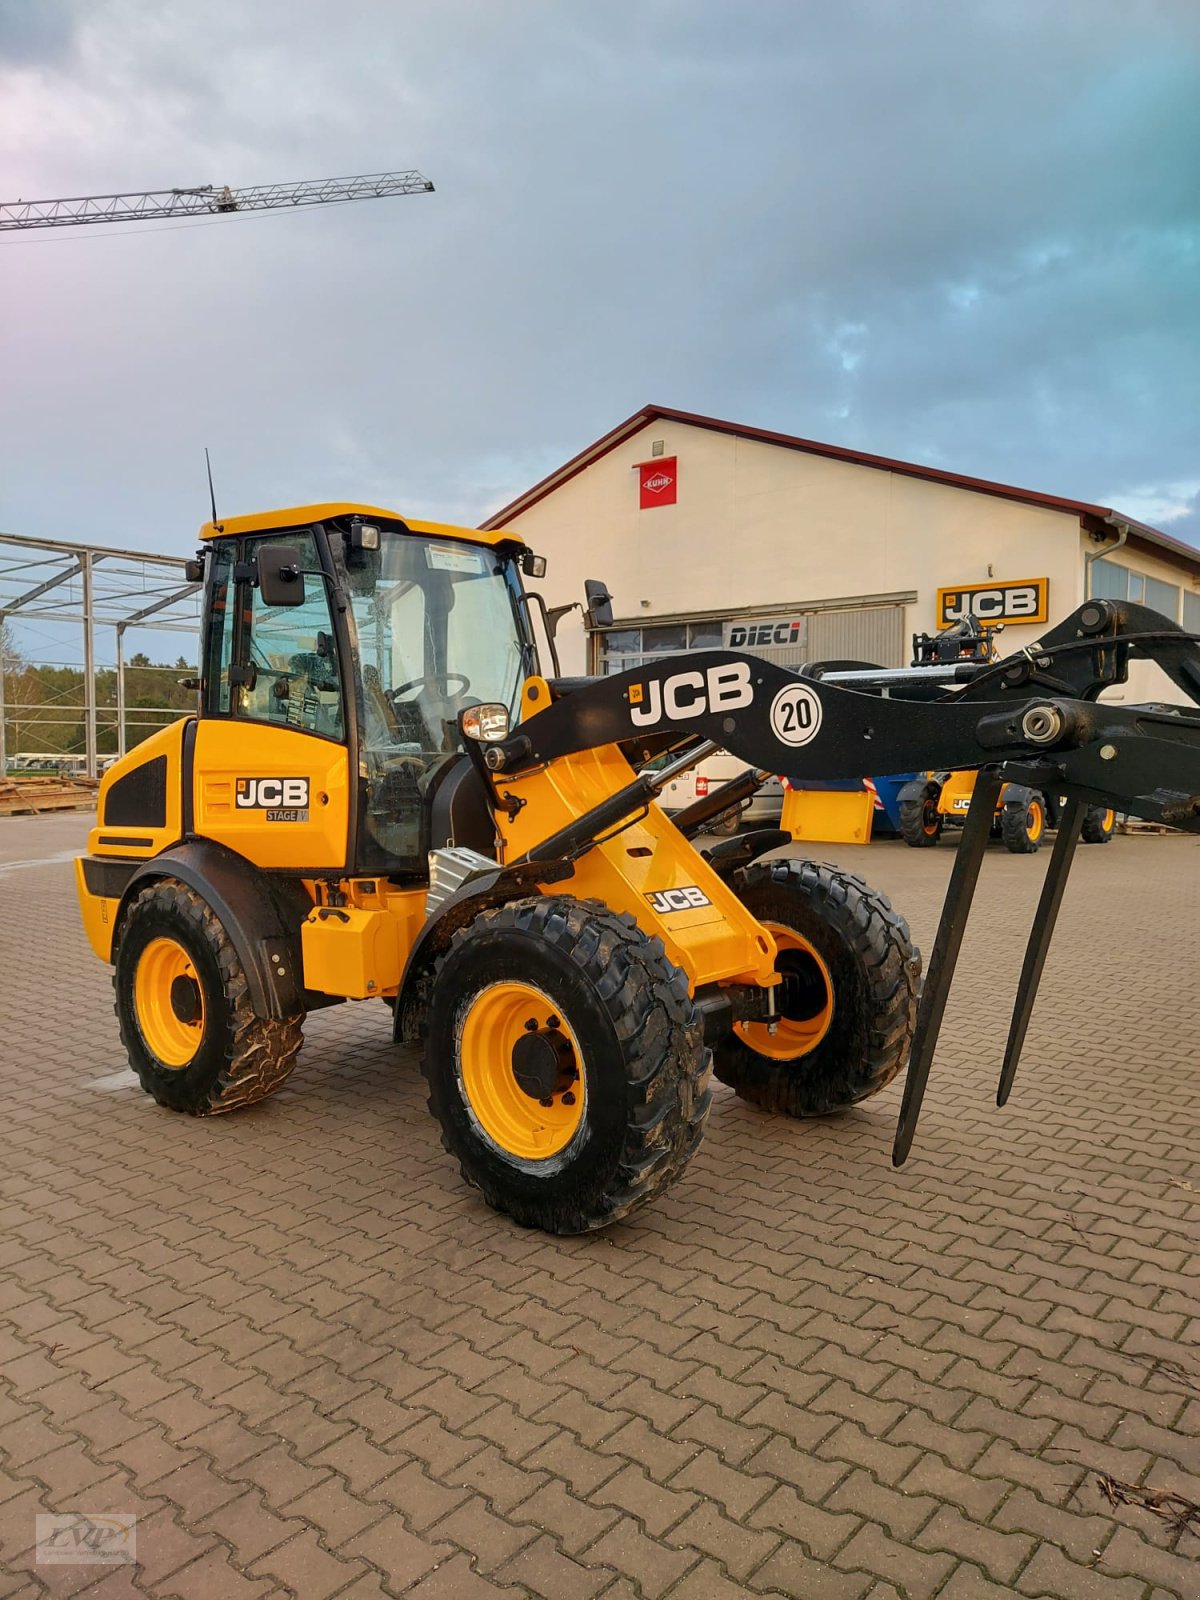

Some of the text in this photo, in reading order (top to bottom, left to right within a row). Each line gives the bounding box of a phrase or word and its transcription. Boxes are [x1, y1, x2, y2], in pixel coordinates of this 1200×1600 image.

[945, 587, 1037, 620] JCB
[630, 661, 754, 727] JCB
[780, 698, 812, 733] 20
[237, 779, 308, 807] JCB
[953, 799, 970, 809] JC
[267, 810, 297, 821] STAGE
[652, 887, 710, 913] JCB
